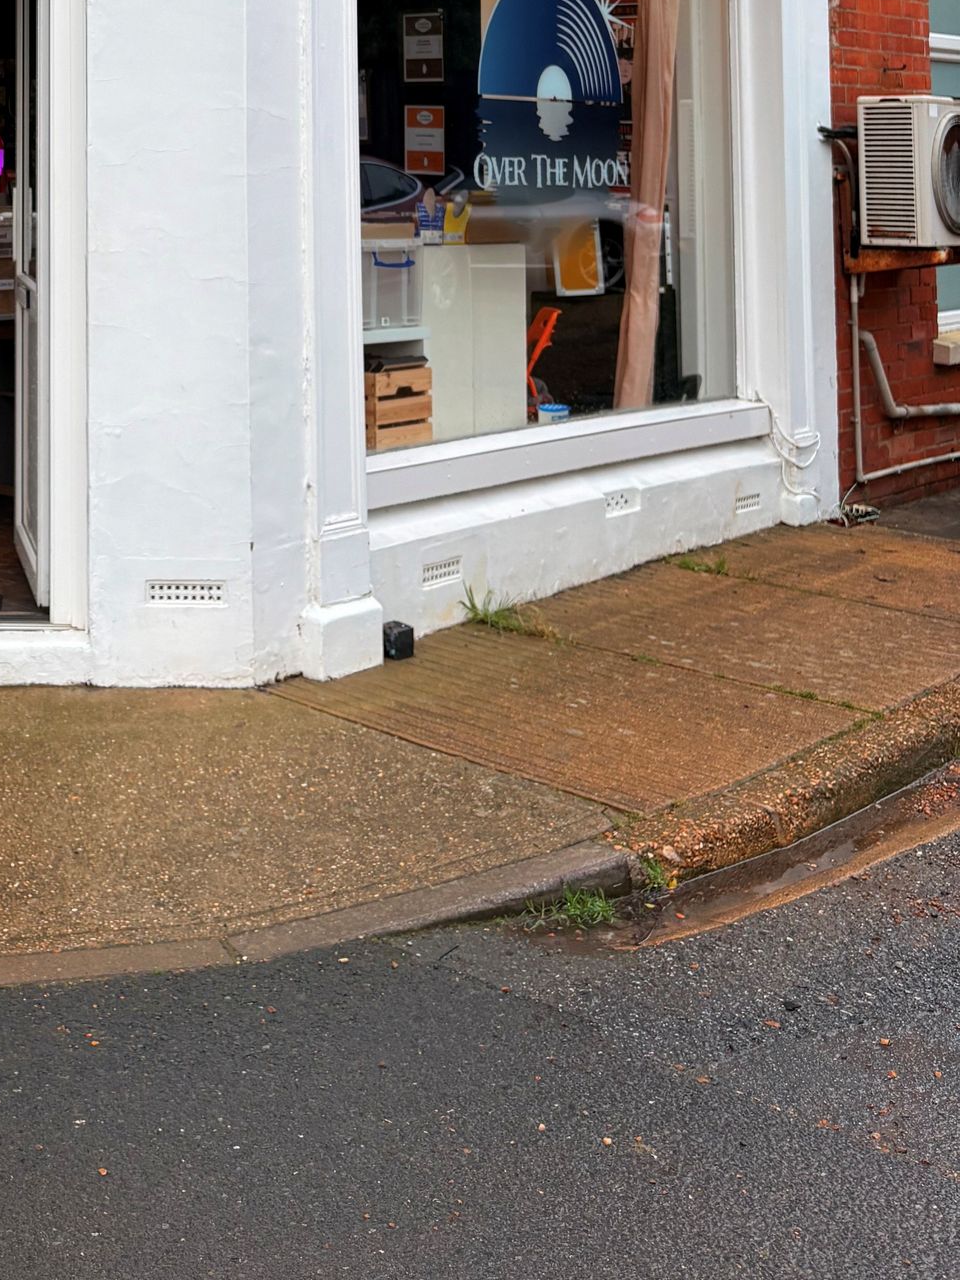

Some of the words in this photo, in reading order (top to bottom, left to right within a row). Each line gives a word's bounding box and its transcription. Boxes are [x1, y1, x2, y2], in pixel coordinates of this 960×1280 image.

[473, 152, 528, 189] OVER
[531, 153, 569, 189] THE
[572, 154, 628, 189] MOON
